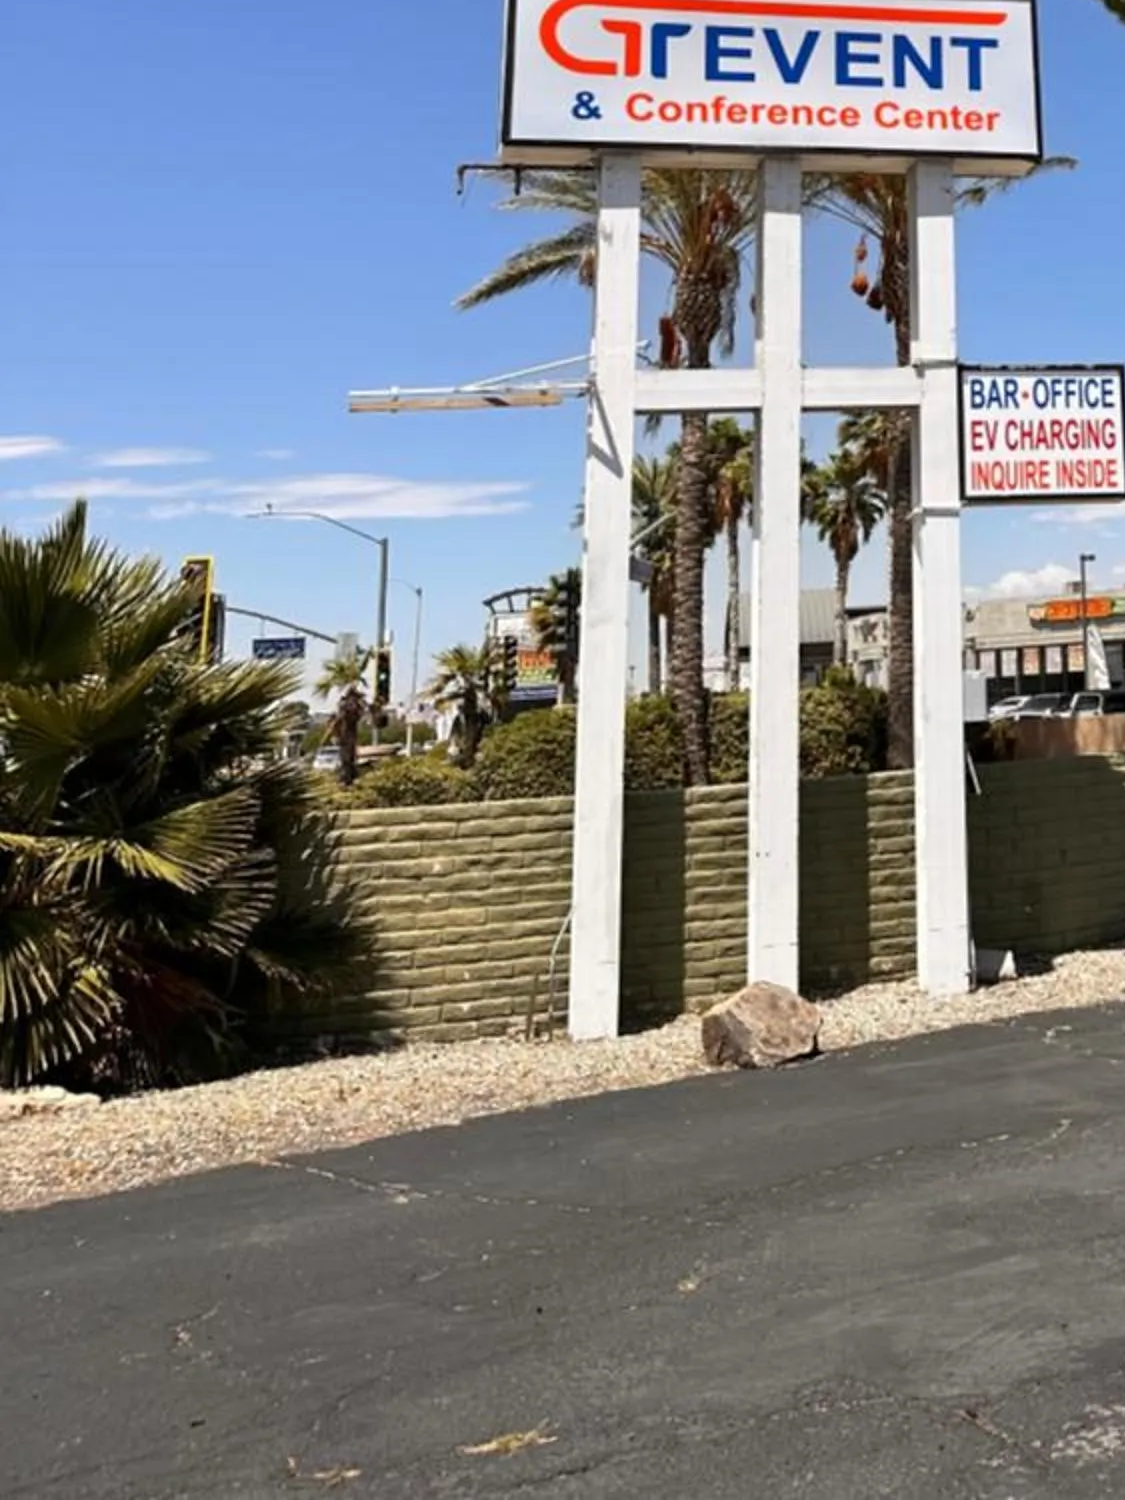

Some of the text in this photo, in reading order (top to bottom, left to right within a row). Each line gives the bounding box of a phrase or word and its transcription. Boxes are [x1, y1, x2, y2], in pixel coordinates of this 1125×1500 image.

[704, 24, 999, 91] EVENT
[571, 91, 1001, 132] & Conference Center
[970, 378, 1116, 410] BAR OFFICE
[970, 418, 1117, 451] EV CHARGING
[970, 459, 1119, 491] INQUIRE INSIDE
